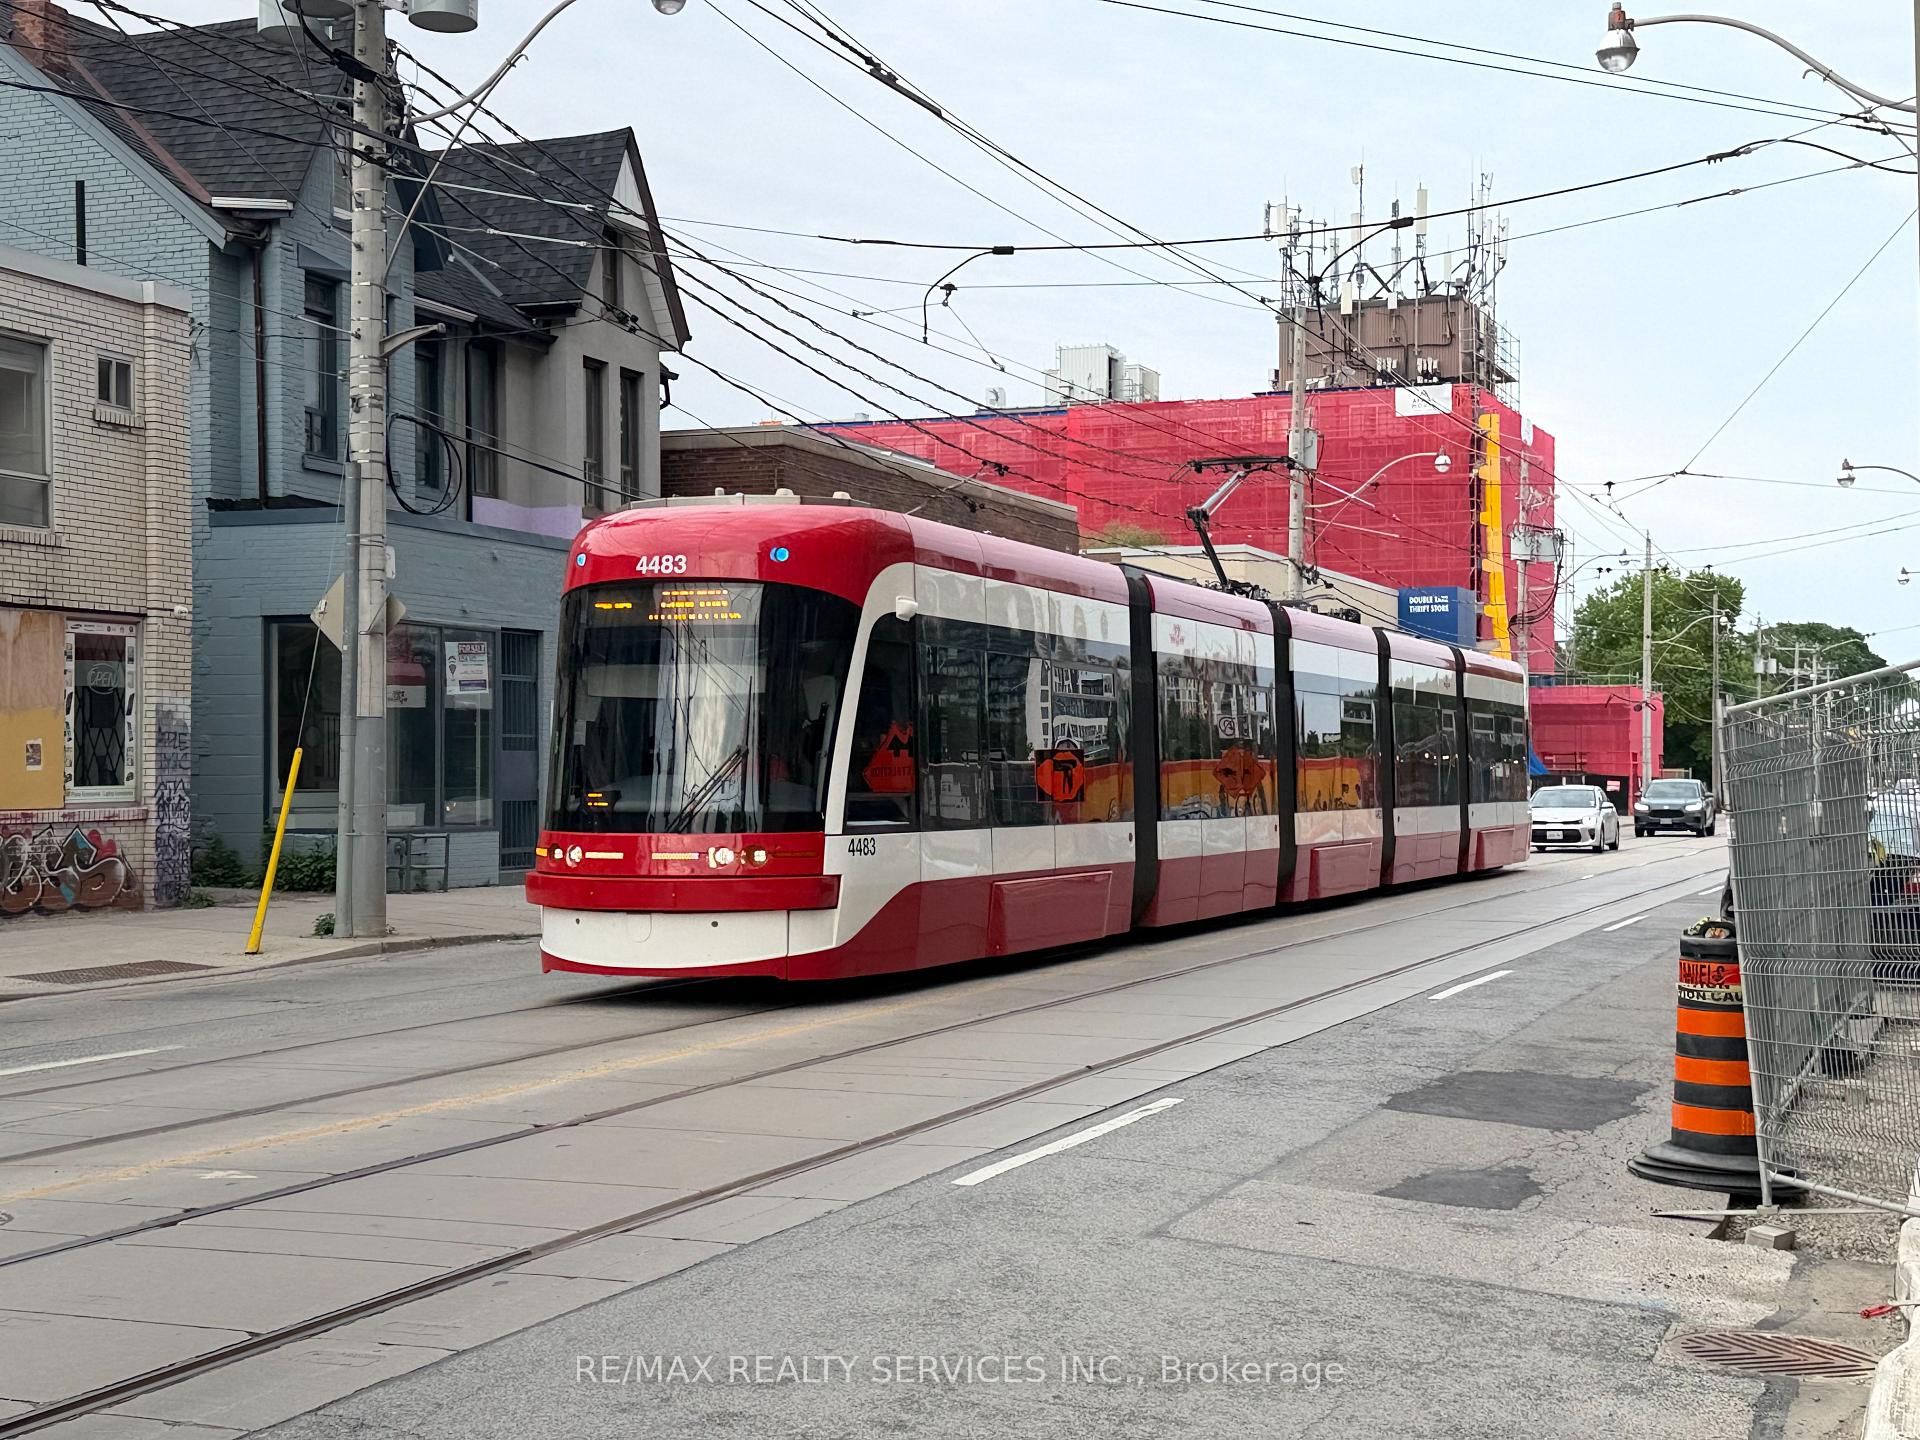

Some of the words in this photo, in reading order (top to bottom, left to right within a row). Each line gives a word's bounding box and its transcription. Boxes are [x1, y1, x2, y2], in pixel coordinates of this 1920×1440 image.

[636, 554, 687, 574] 4483
[1409, 595, 1433, 604] DOUBLE
[1431, 604, 1449, 612] STORE
[848, 837, 876, 857] 4483
